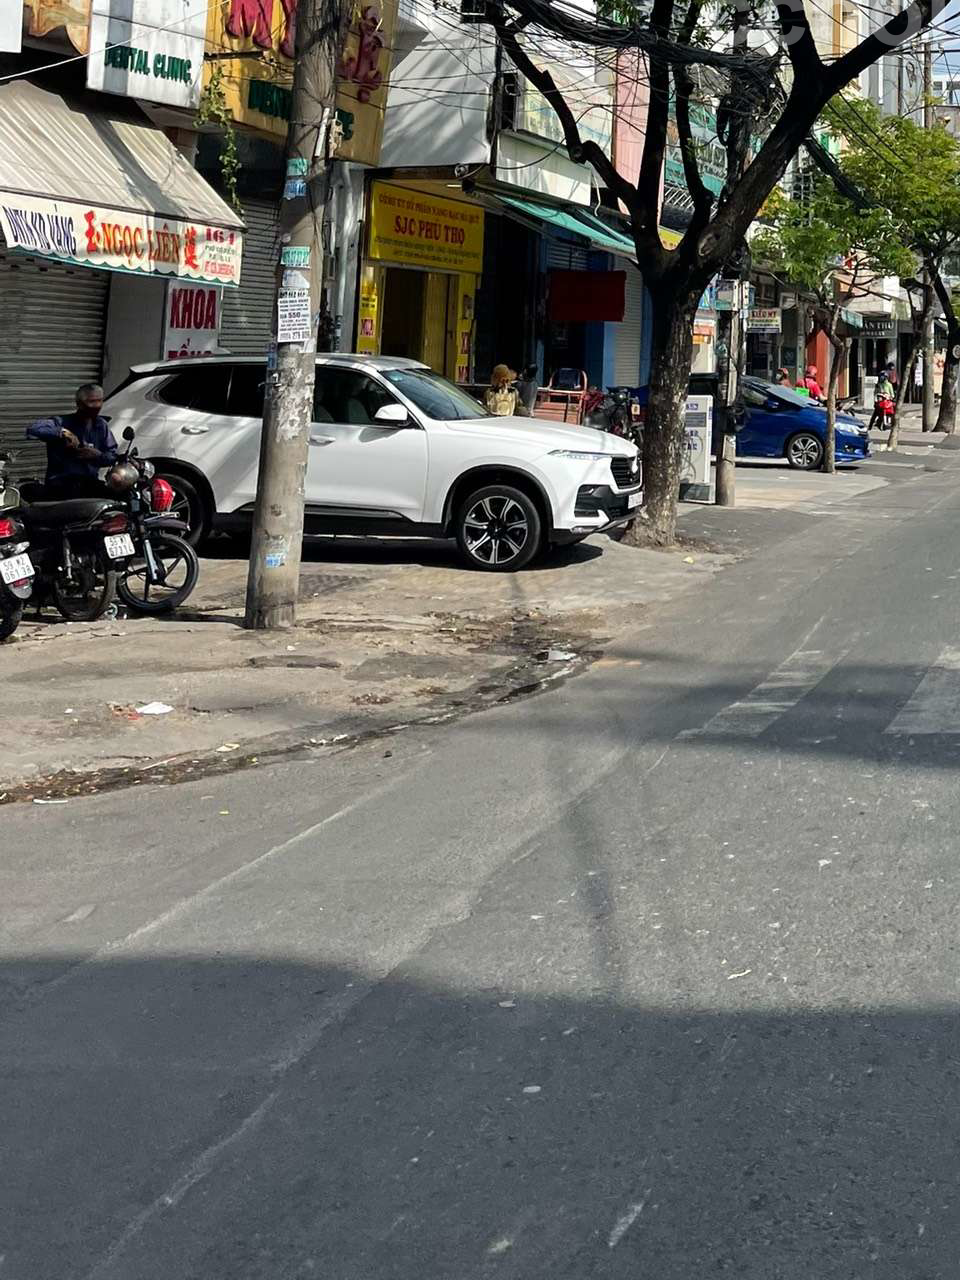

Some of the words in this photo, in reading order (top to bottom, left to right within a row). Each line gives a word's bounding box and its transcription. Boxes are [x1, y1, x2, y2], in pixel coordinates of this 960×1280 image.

[101, 222, 145, 266] NGỌC
[147, 223, 180, 263] LIÊN
[394, 215, 416, 235] SJC
[170, 288, 216, 329] KHOA
